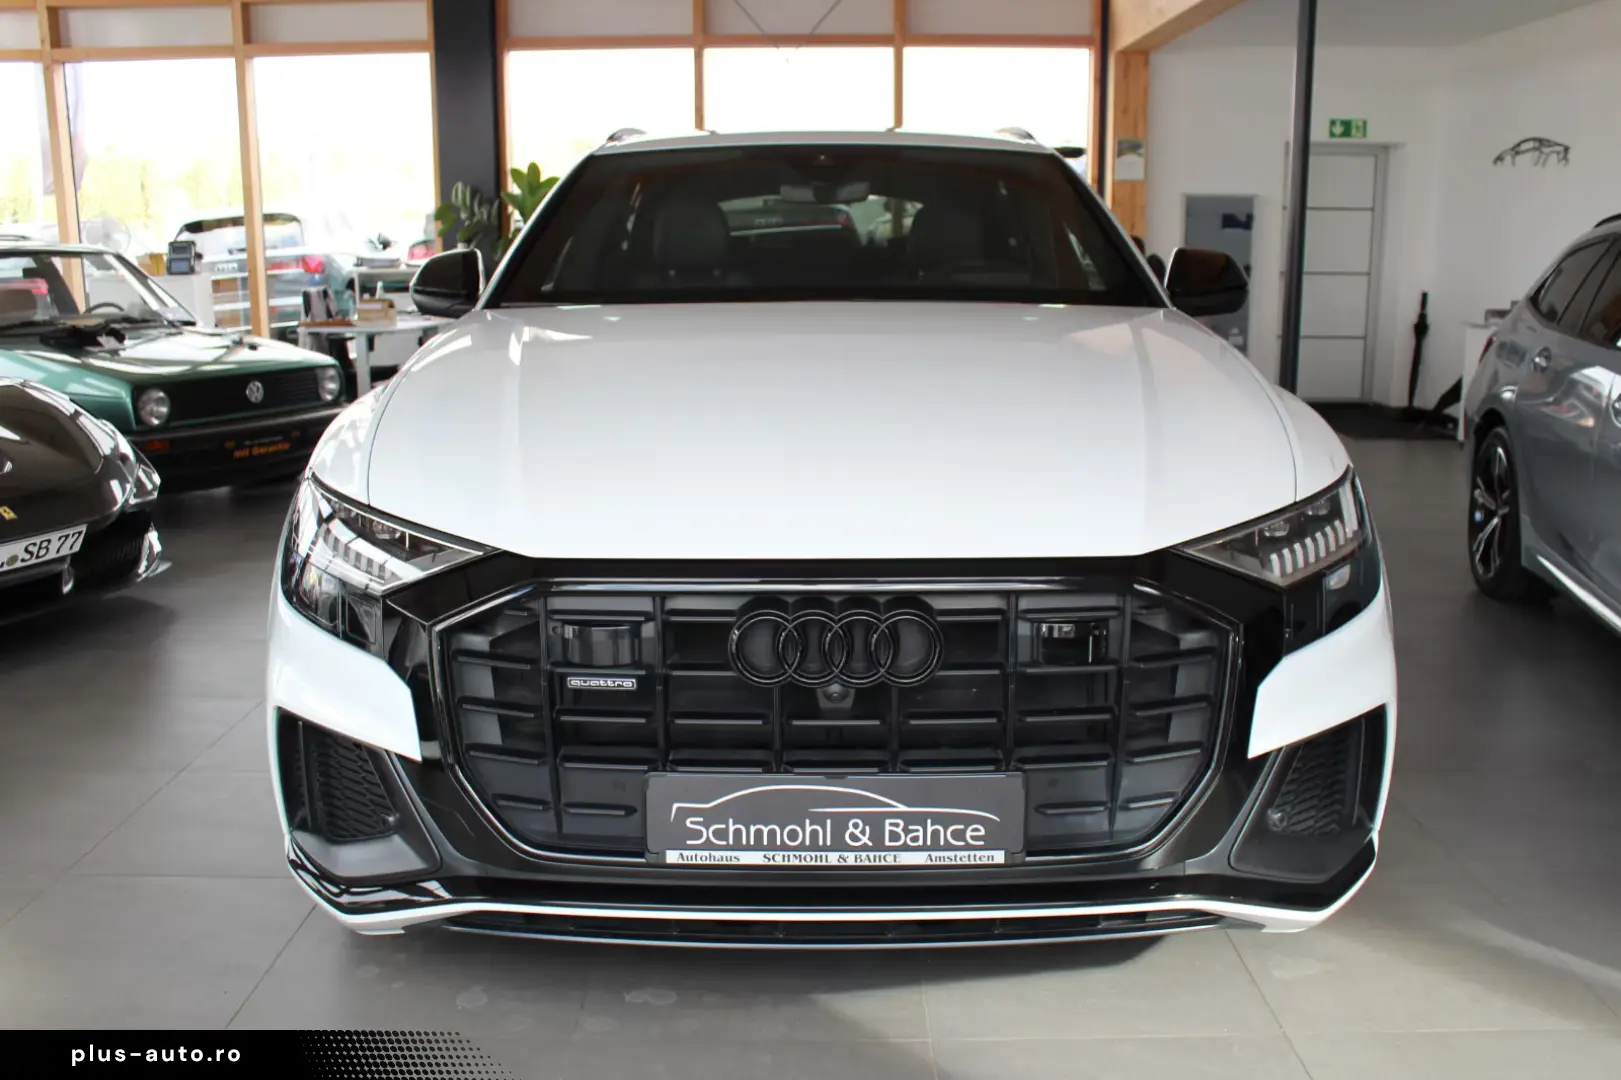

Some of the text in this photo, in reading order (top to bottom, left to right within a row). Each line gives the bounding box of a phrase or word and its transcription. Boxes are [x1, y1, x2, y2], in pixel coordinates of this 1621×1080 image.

[20, 529, 84, 563] SB 77
[570, 679, 633, 687] quattro
[685, 817, 985, 846] Schmohl & Bahce
[677, 852, 995, 864] Autohaus SCHMOHL & BAHCE Amstetten
